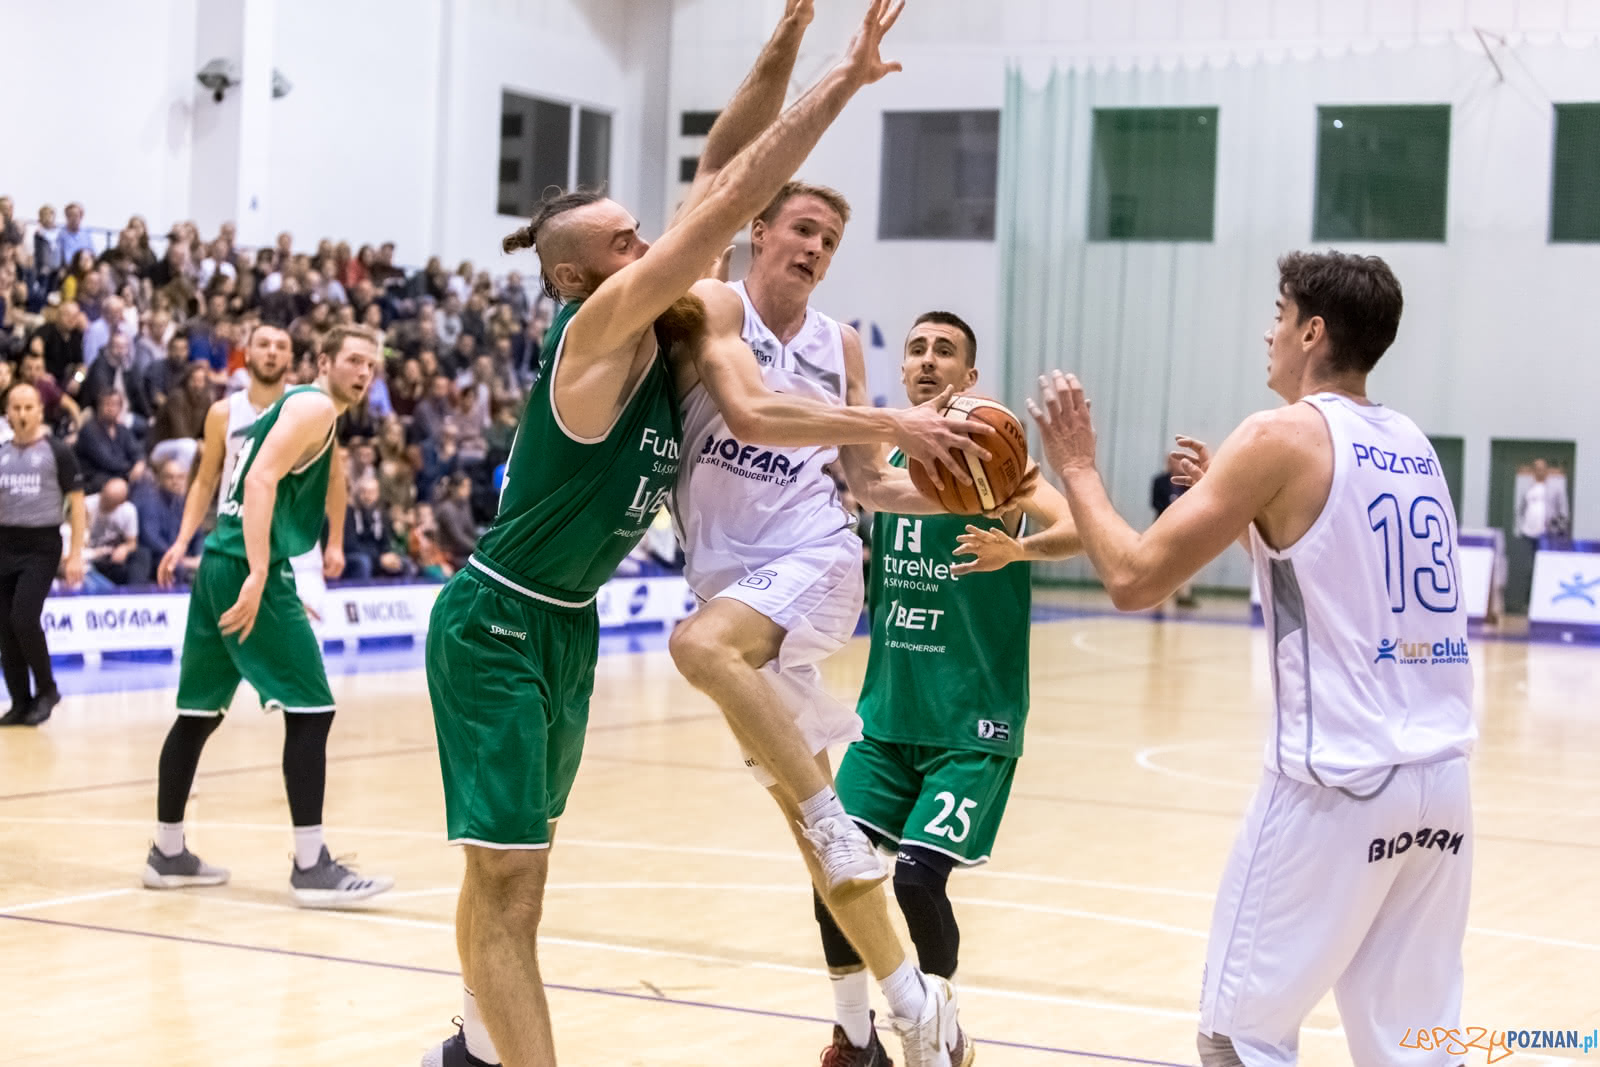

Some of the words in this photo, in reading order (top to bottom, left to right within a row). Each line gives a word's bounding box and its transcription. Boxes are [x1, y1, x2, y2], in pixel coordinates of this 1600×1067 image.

[720, 462, 773, 484] PRODUCENT
[1367, 492, 1459, 614] 13
[738, 569, 778, 590] 6
[490, 624, 527, 641] SPALDING
[923, 791, 978, 843] 25
